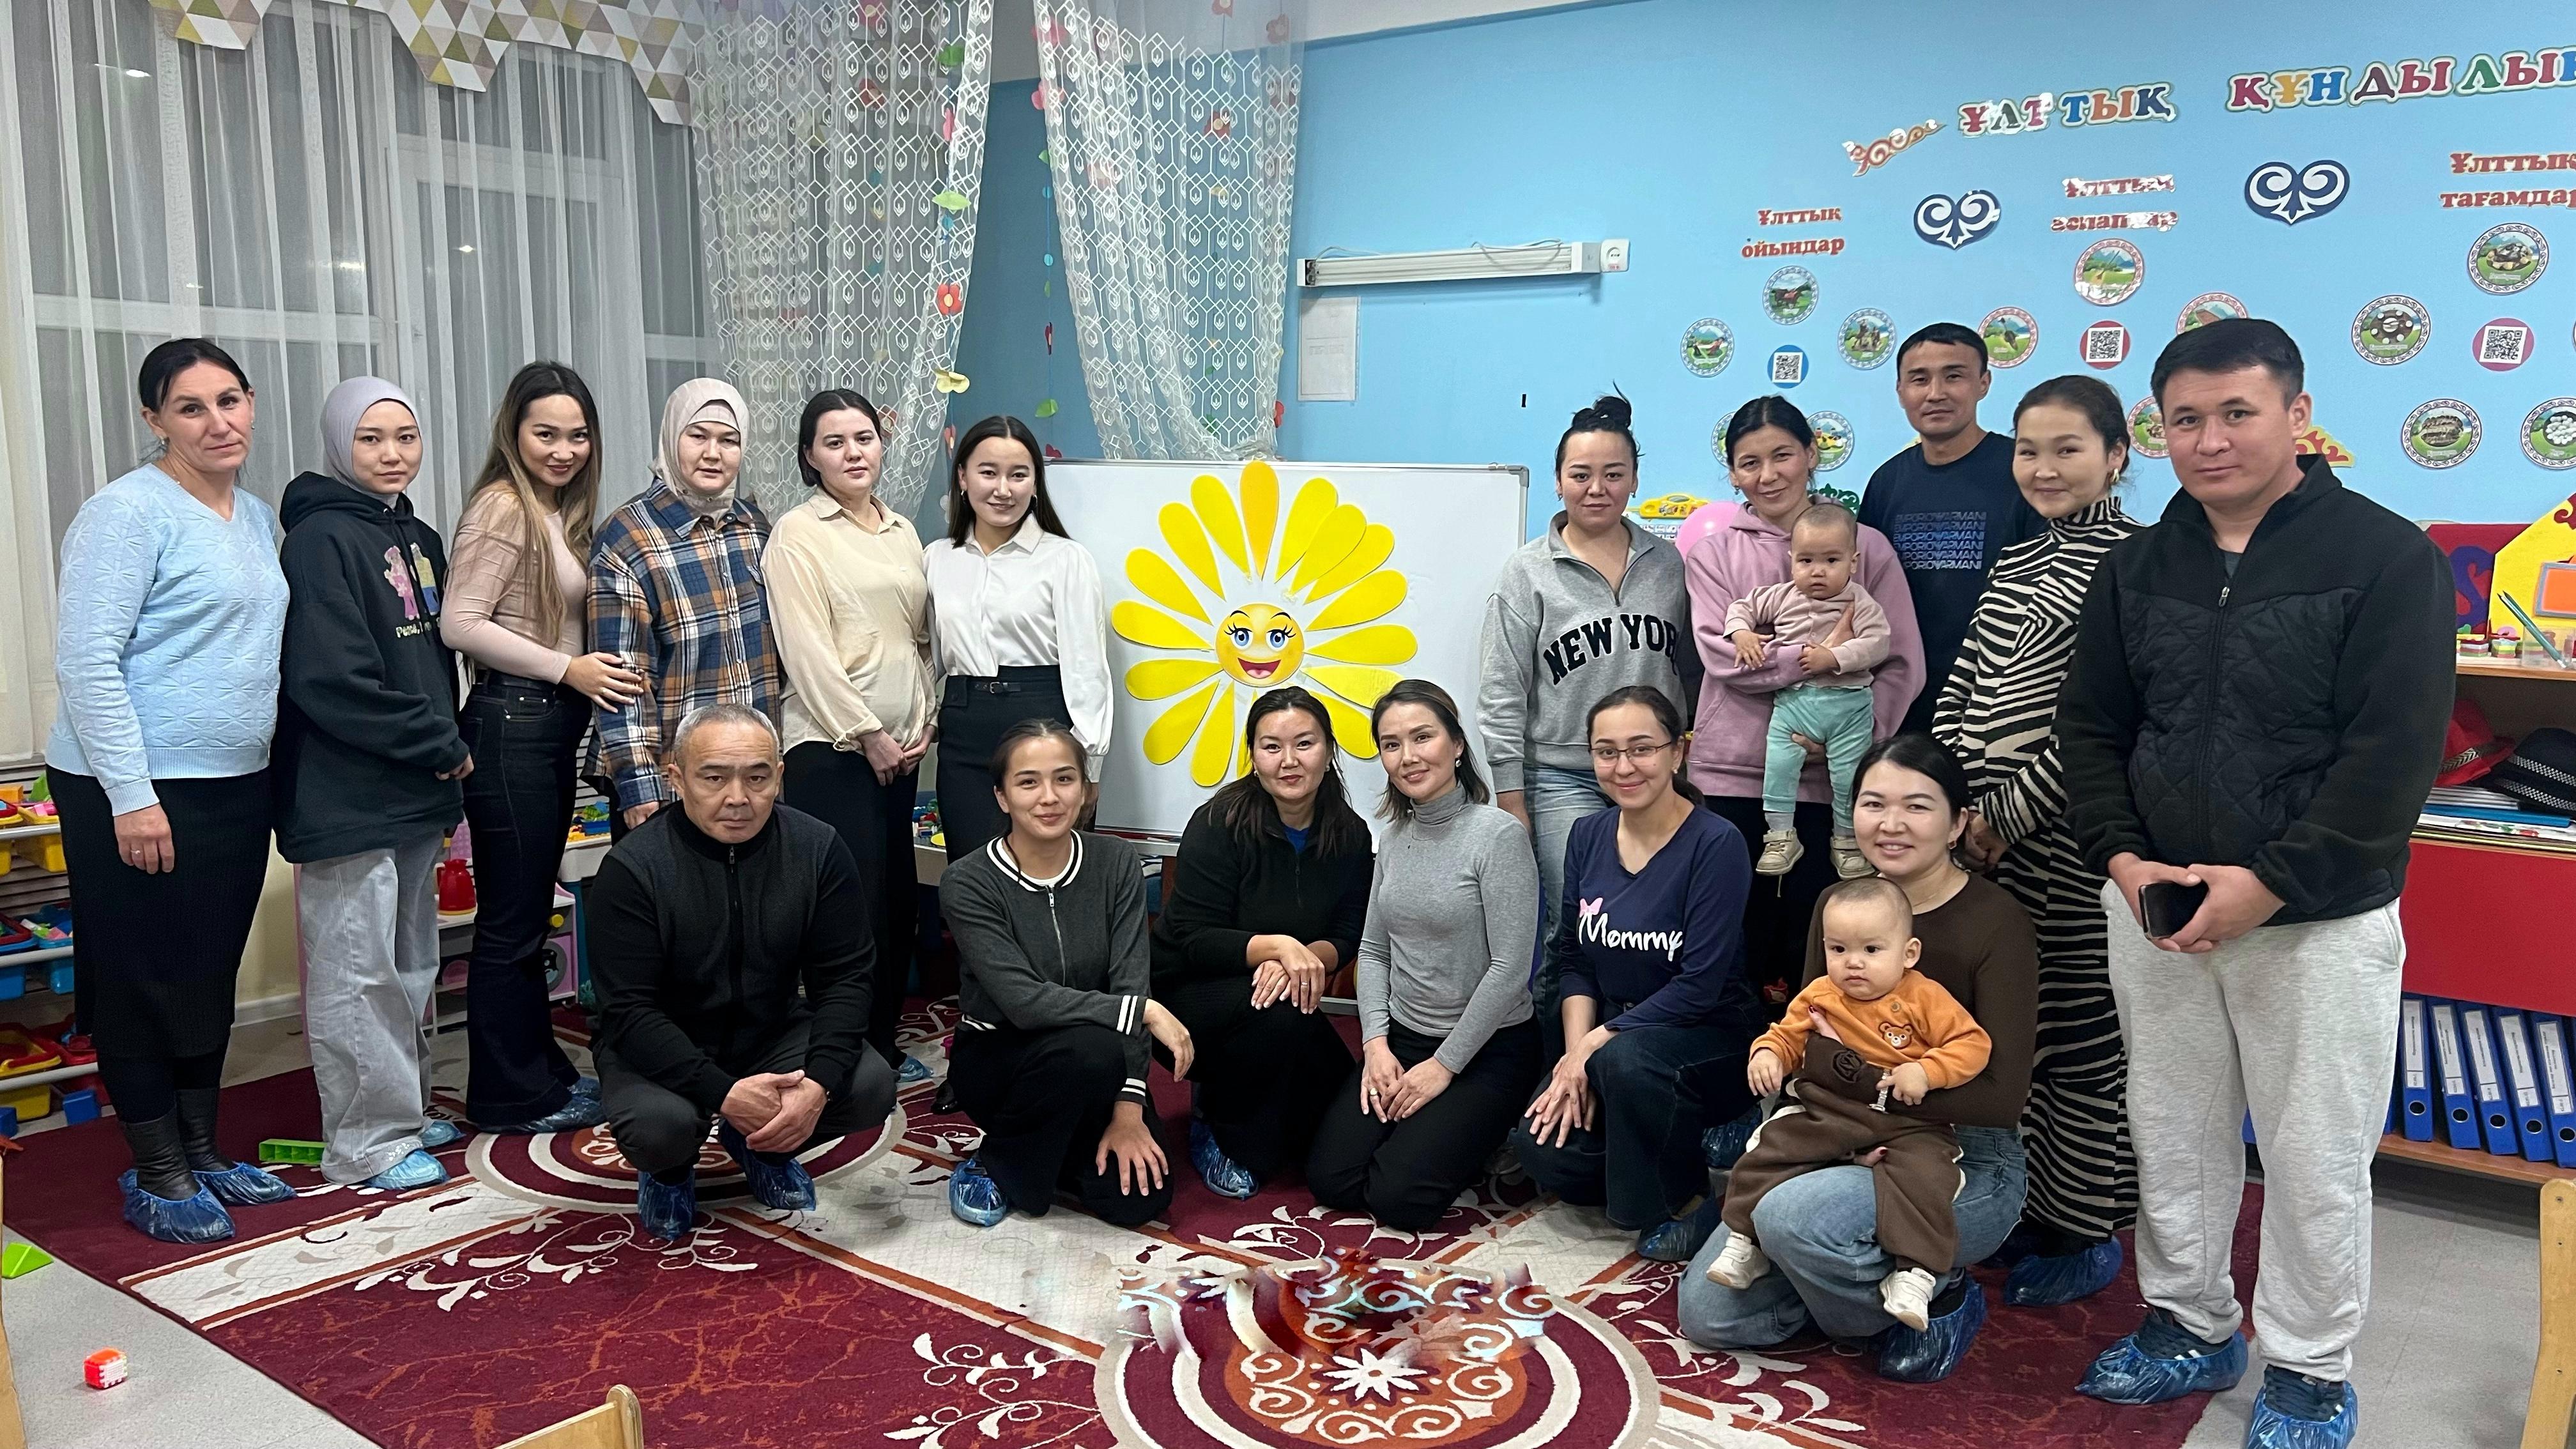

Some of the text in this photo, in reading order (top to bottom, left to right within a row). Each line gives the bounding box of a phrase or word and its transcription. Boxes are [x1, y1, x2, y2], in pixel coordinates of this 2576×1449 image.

[1758, 208, 1842, 226] Ұлттық
[1742, 238, 1845, 258] ойындар
[1543, 614, 1678, 686] NEW YOR
[1577, 912, 1683, 962] Mommy
